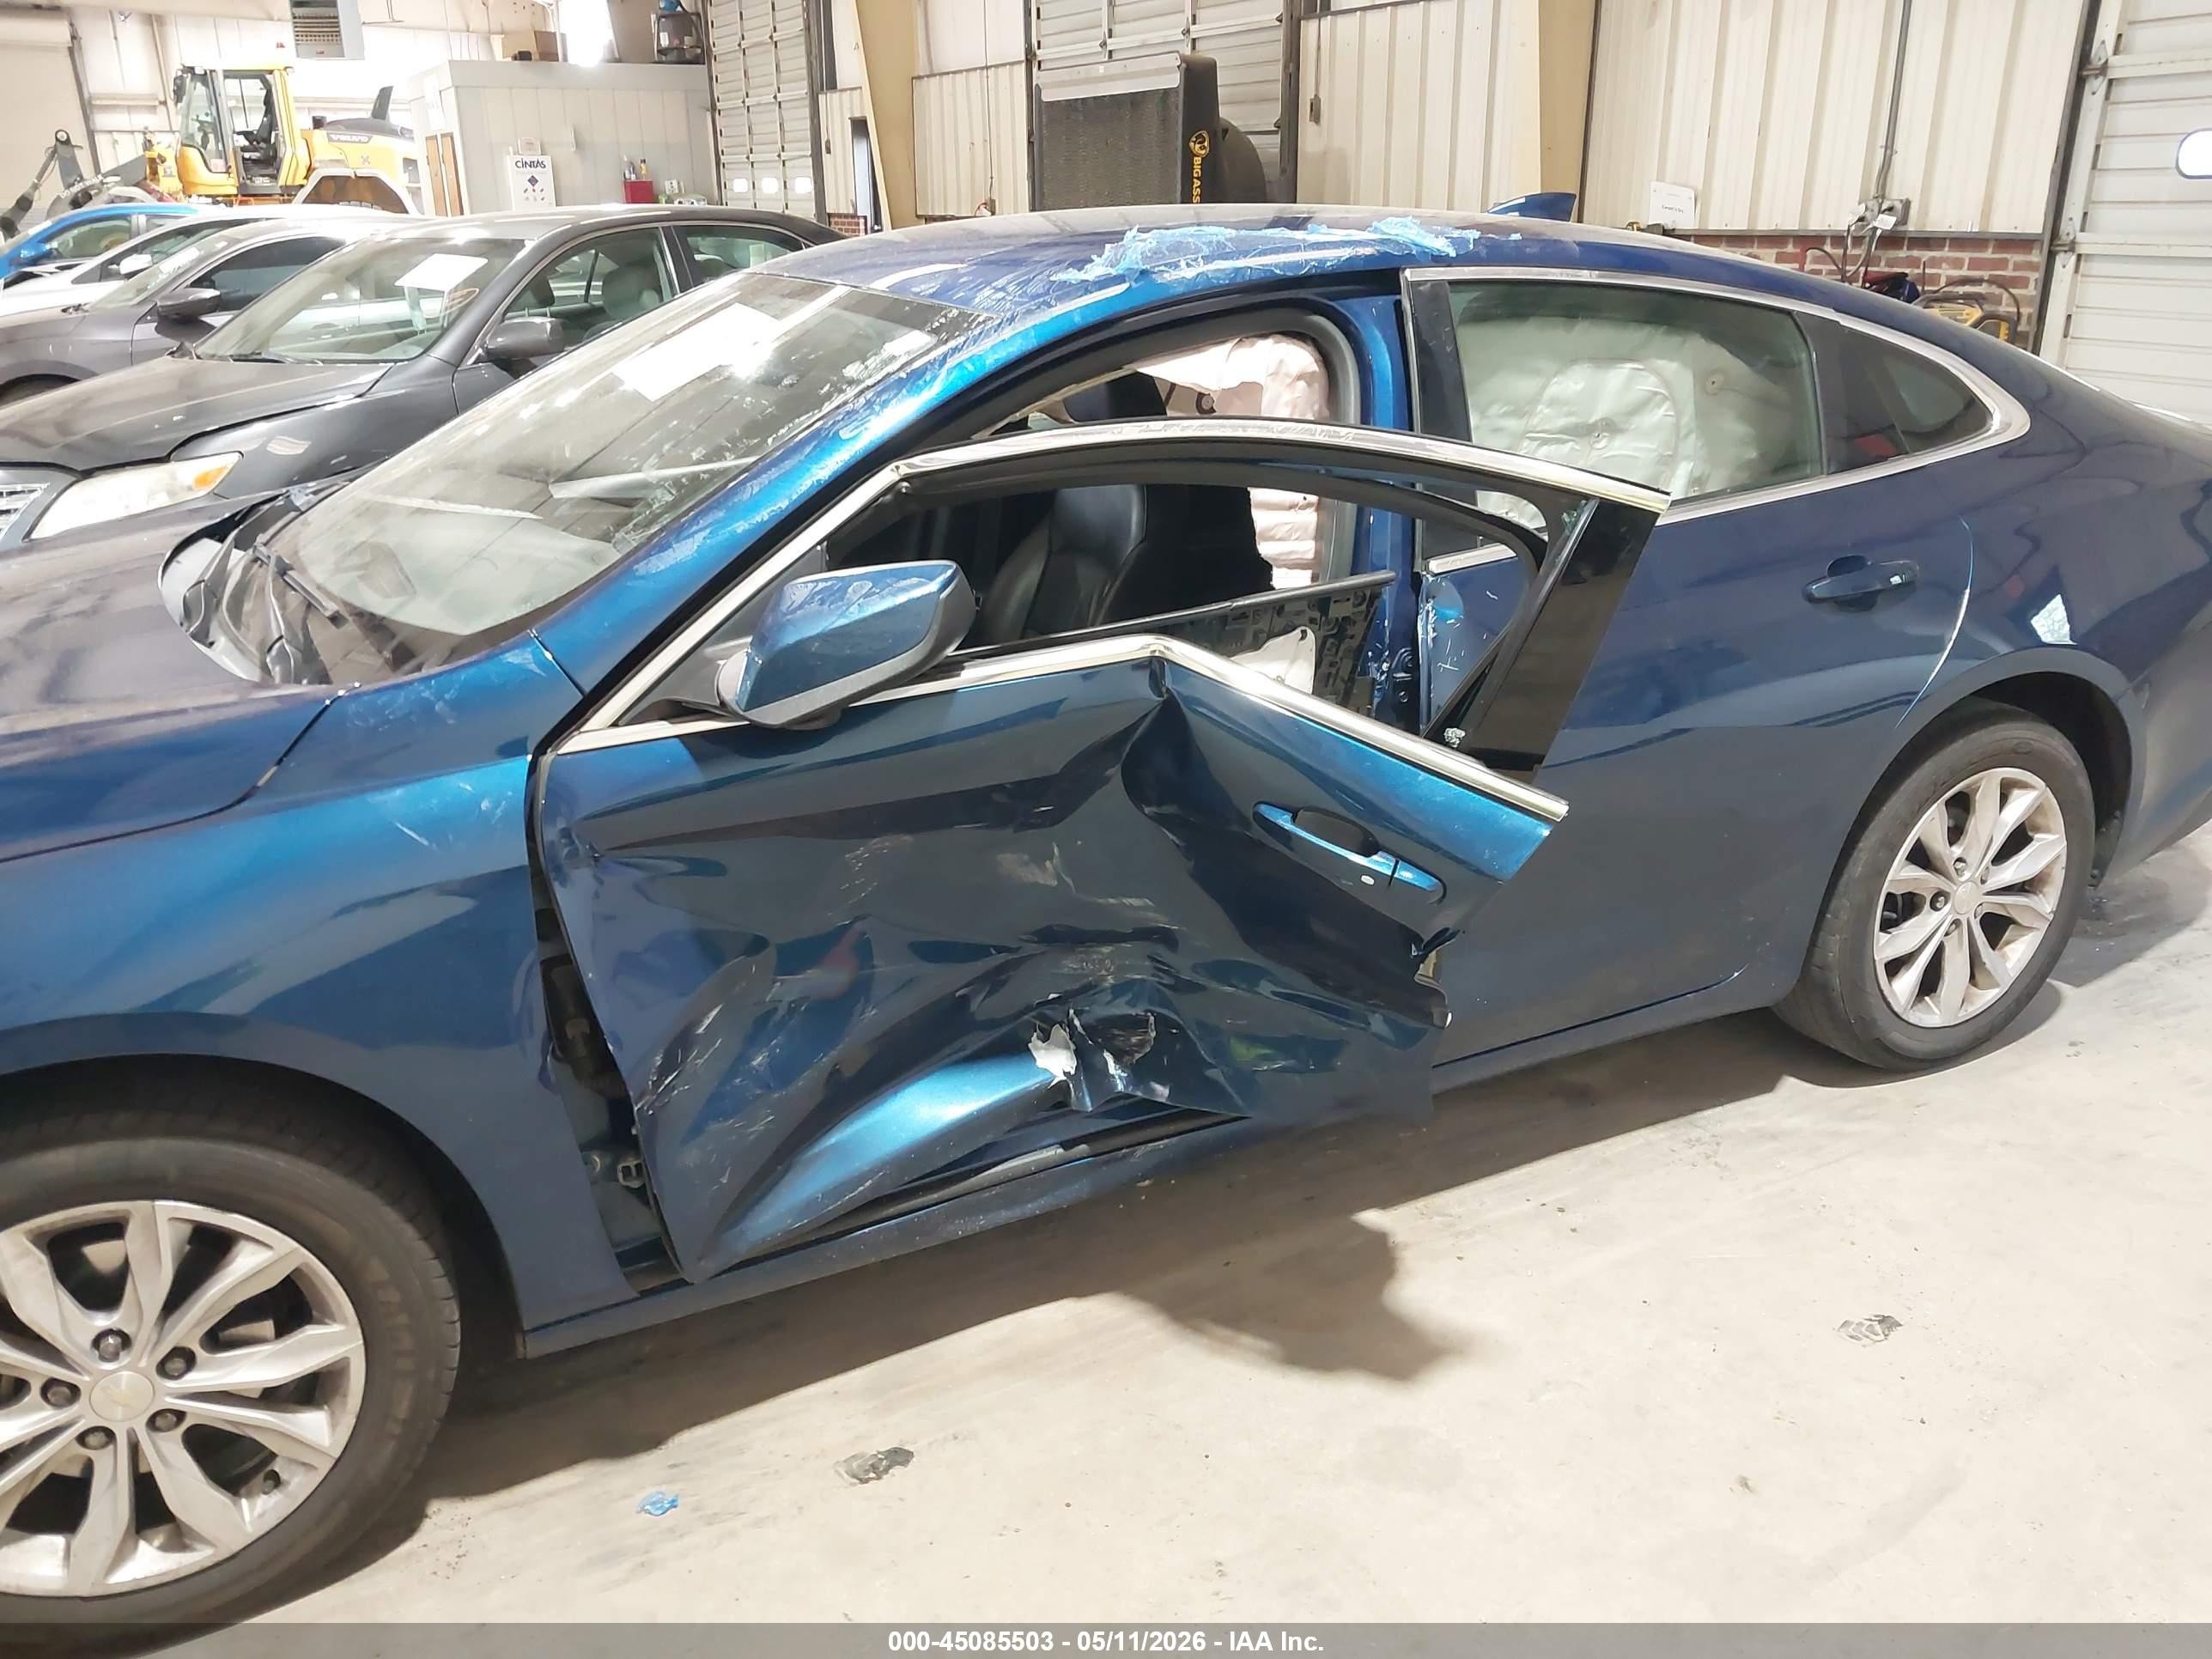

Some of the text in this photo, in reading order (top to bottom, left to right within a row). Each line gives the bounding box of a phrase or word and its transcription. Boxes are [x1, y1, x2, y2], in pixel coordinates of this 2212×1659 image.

[514, 157, 546, 169] CINTAS
[1192, 156, 1202, 204] BIG ASS
